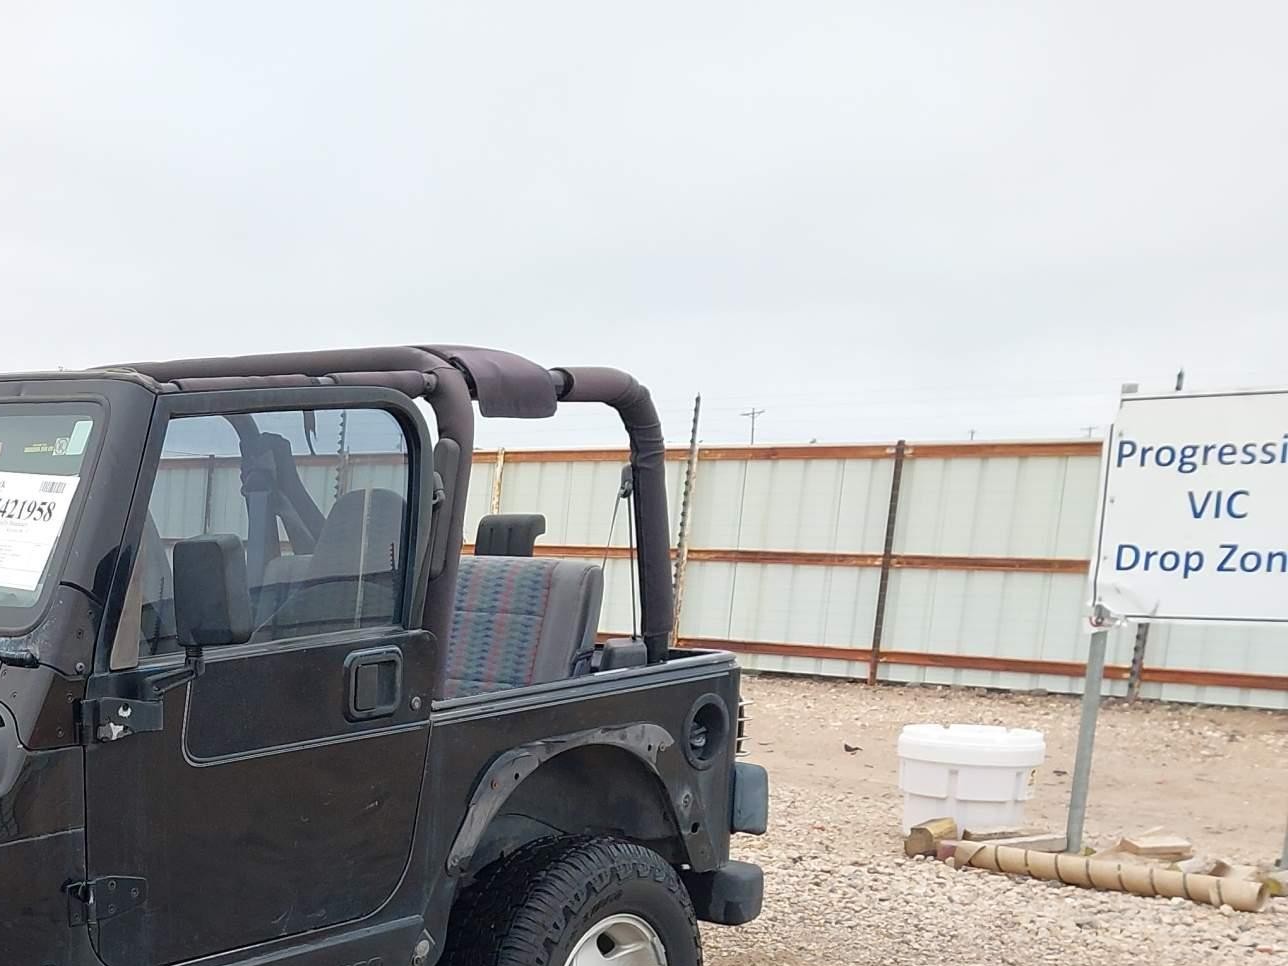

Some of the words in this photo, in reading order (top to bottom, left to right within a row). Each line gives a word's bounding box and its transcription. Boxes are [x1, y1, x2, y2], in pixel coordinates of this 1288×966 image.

[1116, 434, 1288, 474] Progressi
[1188, 490, 1250, 519] VIC
[1115, 544, 1205, 579] Drop
[1216, 544, 1288, 573] Zon
